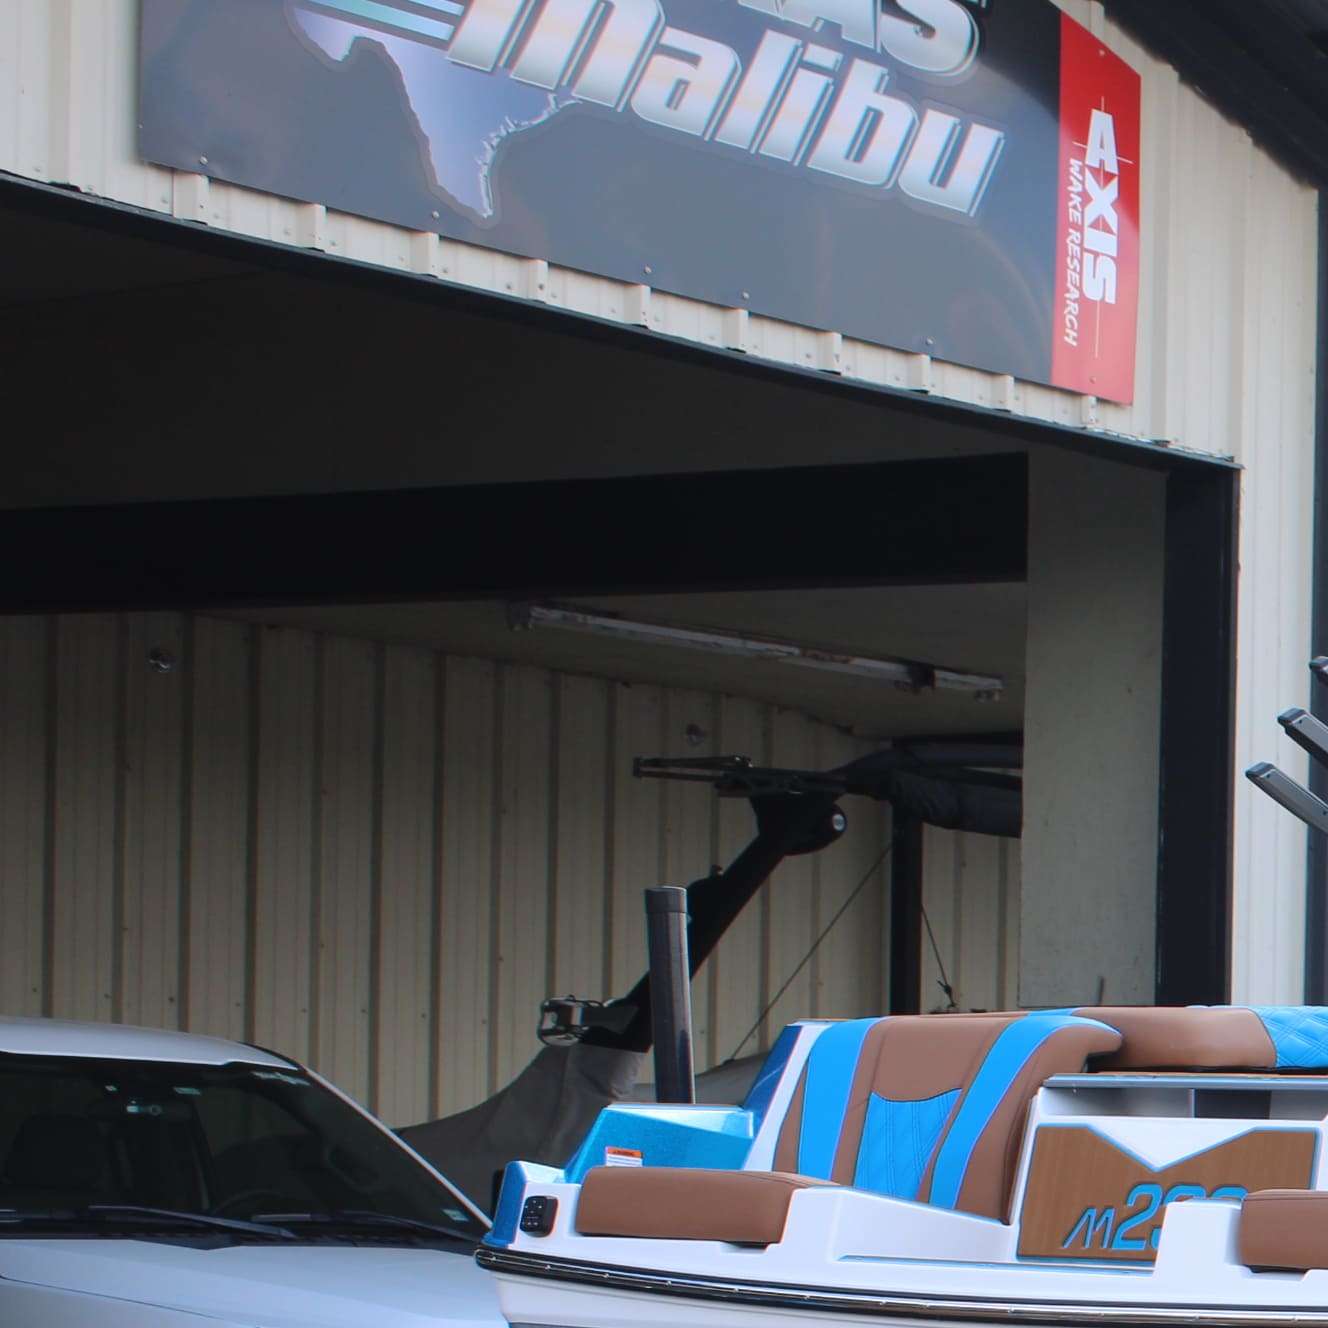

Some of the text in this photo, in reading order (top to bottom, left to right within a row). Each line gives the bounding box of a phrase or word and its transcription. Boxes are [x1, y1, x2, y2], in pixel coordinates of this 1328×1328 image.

[446, 0, 1005, 217] Malibu
[1083, 108, 1119, 305] AXIS
[1063, 157, 1083, 347] WAKE RESEARCH
